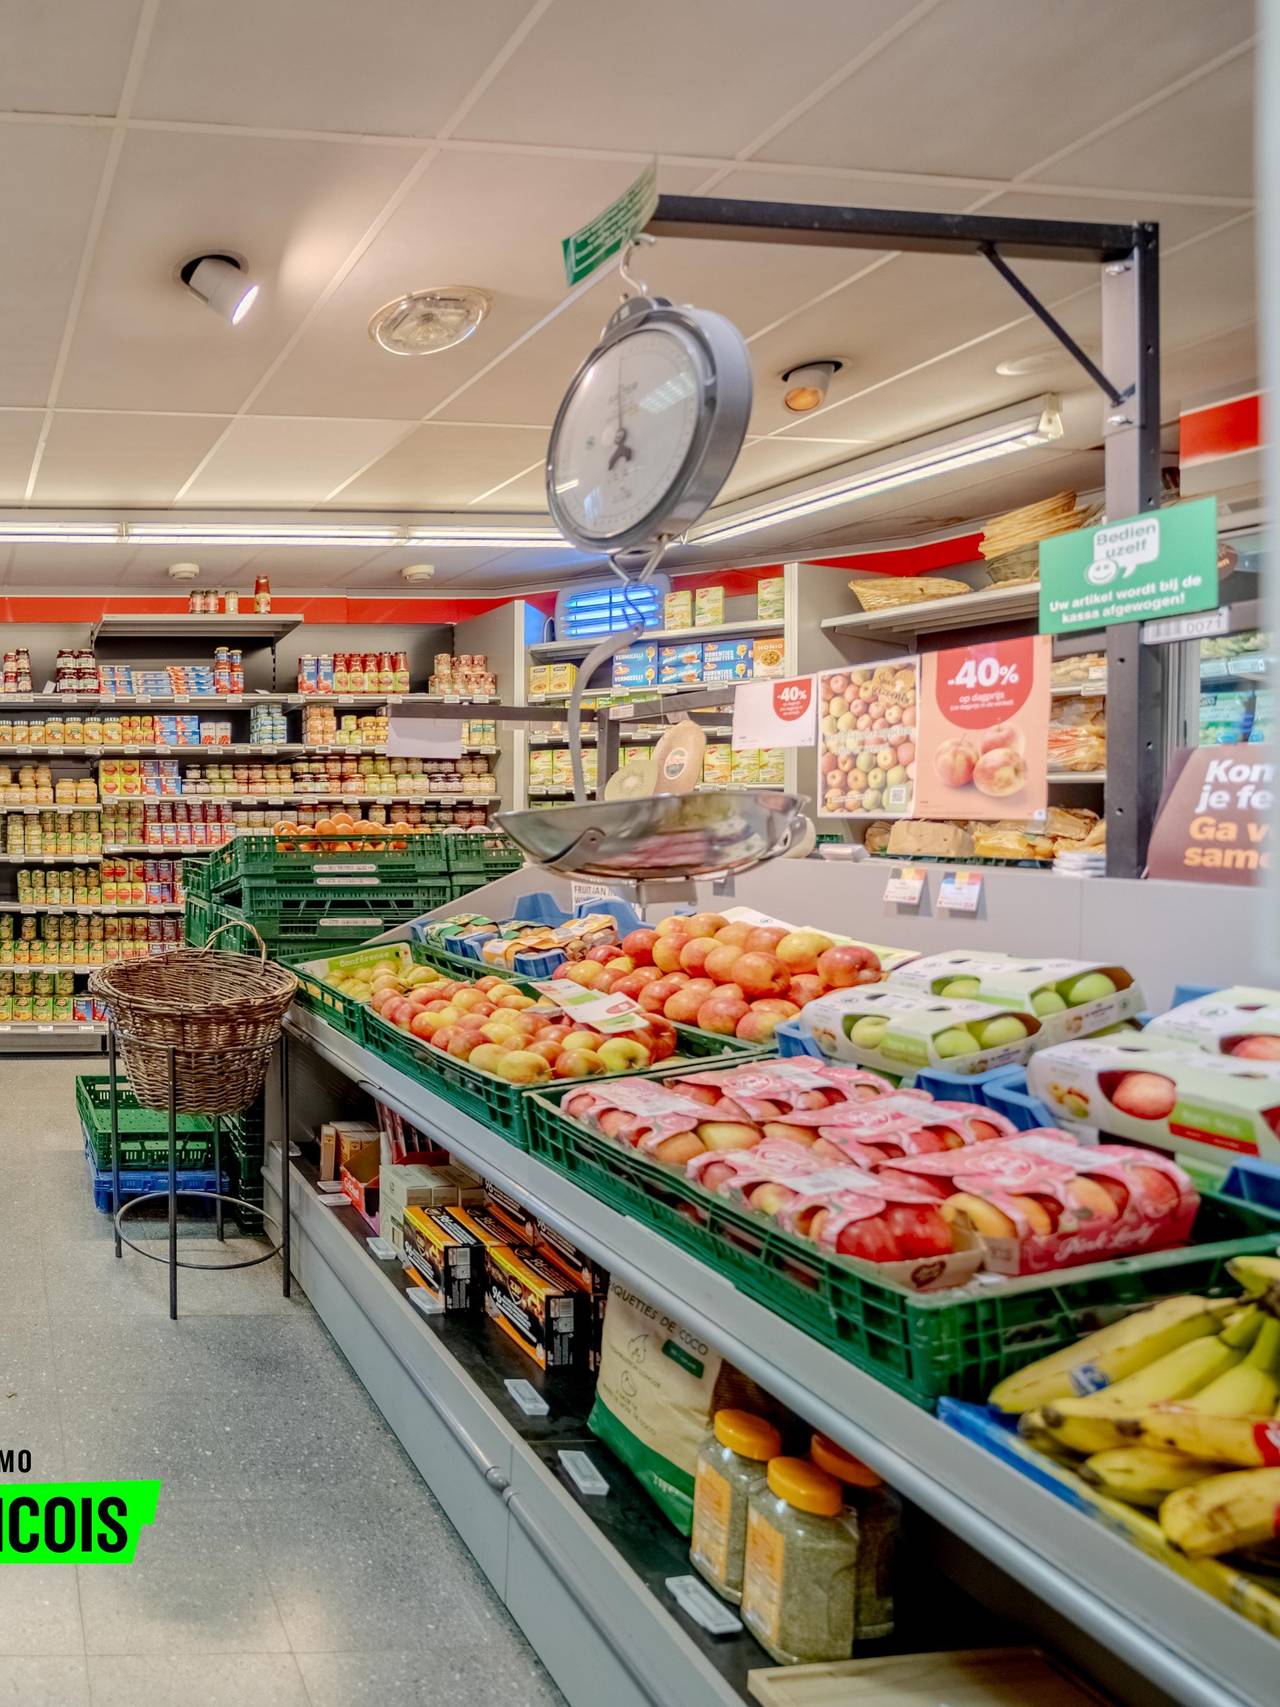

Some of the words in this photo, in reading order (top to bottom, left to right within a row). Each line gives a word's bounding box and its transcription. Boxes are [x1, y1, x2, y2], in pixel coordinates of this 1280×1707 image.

[1096, 522, 1157, 546] Bedien
[1106, 539, 1147, 559] uzelf
[1049, 601, 1069, 613] Uw
[1072, 590, 1113, 609] artikel
[1116, 582, 1156, 600] wordt
[1159, 577, 1178, 594] bij
[1182, 575, 1202, 589] de
[1062, 608, 1100, 624] kassa
[1102, 592, 1186, 619] afgewogen!
[948, 656, 1019, 689] -40%
[959, 694, 971, 704] op
[971, 691, 1005, 703] dagprijs
[1194, 783, 1230, 814] je
[1189, 816, 1238, 842] Ga
[609, 1281, 659, 1321] IQUETTES
[660, 1314, 676, 1334] DE
[678, 1328, 709, 1357] COCO
